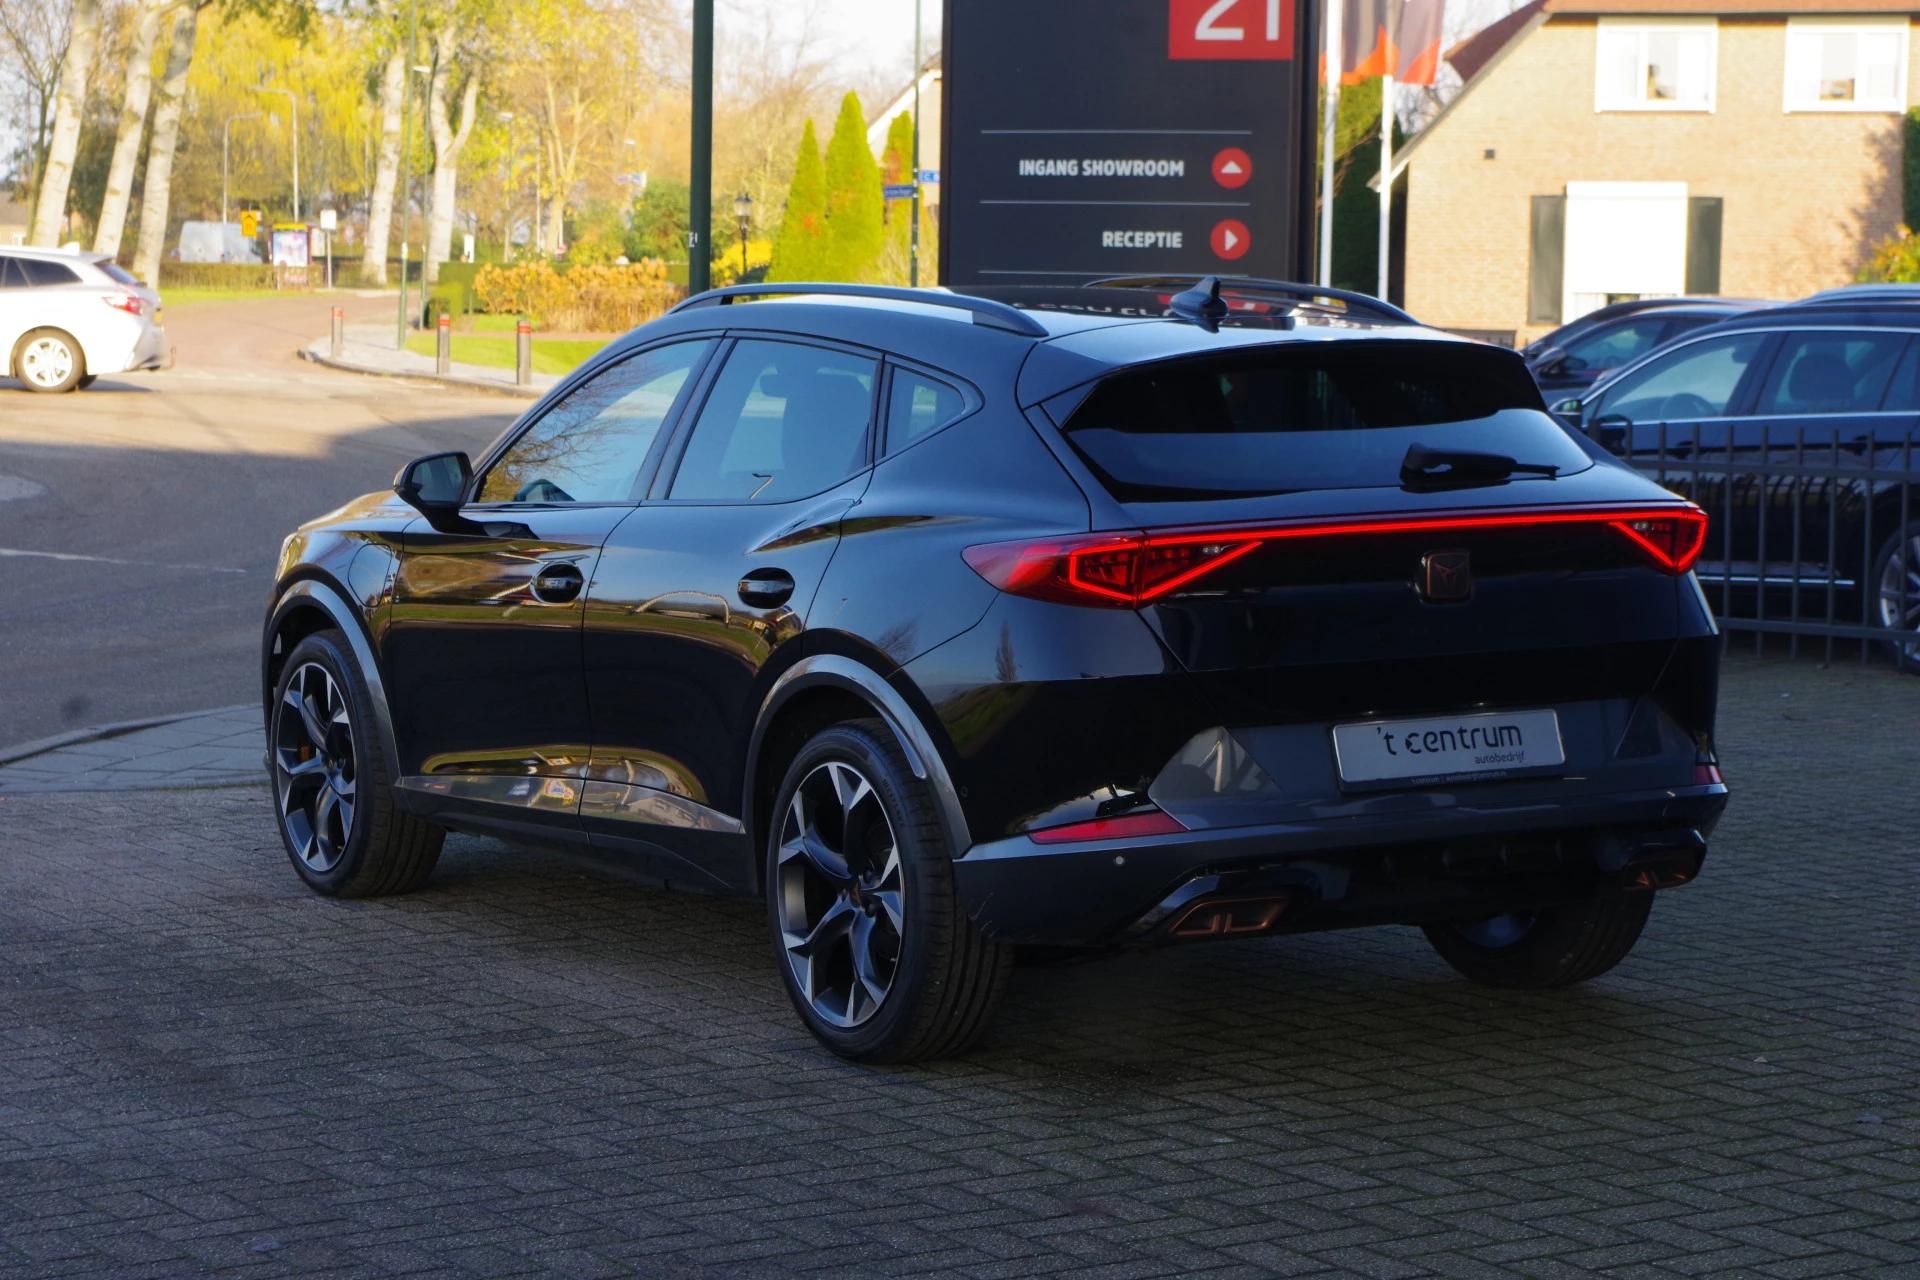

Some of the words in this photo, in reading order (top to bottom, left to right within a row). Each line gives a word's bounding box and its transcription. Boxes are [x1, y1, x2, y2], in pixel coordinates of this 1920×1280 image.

[1019, 159, 1079, 176] INGANG
[1082, 159, 1184, 177] SHOWROOM
[1102, 231, 1183, 248] RECEPTIE
[1376, 726, 1397, 755] 't
[1405, 725, 1523, 754] centrum
[1474, 750, 1525, 764] autobedrijf
